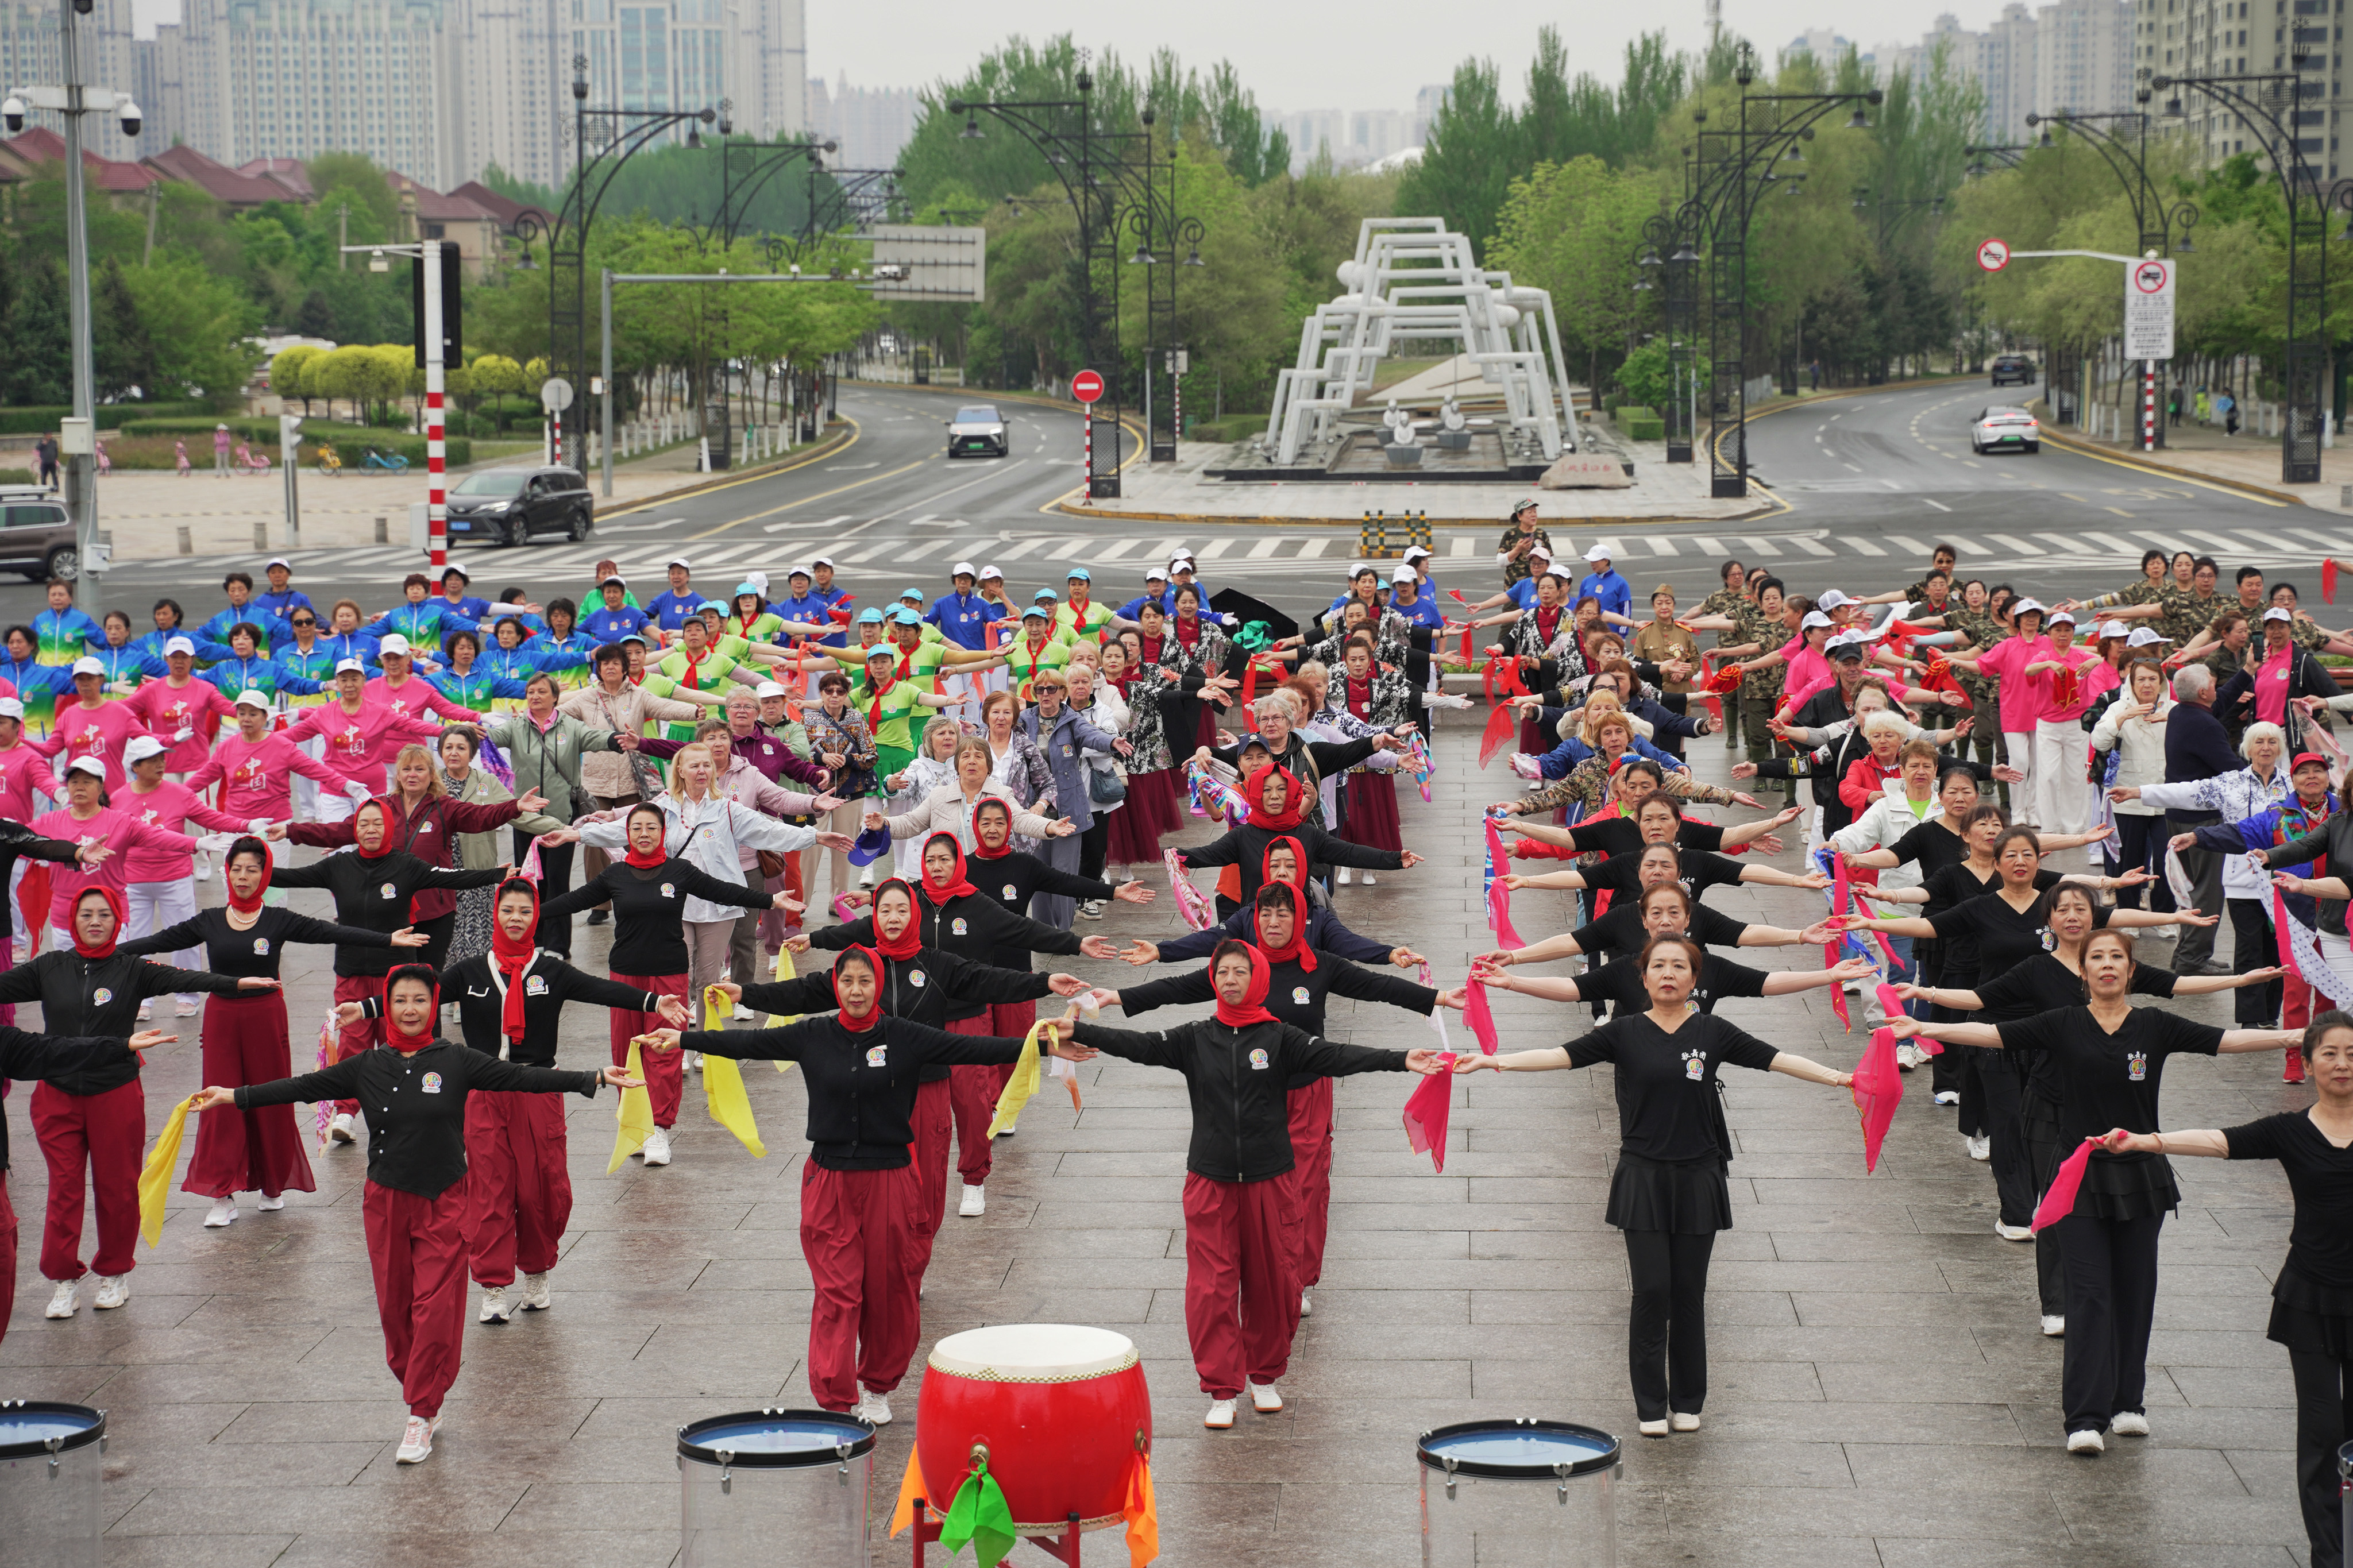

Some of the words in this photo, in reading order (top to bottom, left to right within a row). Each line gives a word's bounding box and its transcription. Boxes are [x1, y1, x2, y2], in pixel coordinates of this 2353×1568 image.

[173, 700, 192, 729] 中国
[84, 724, 106, 756] 中国
[344, 724, 365, 756] 中国
[245, 756, 266, 791] 中国
